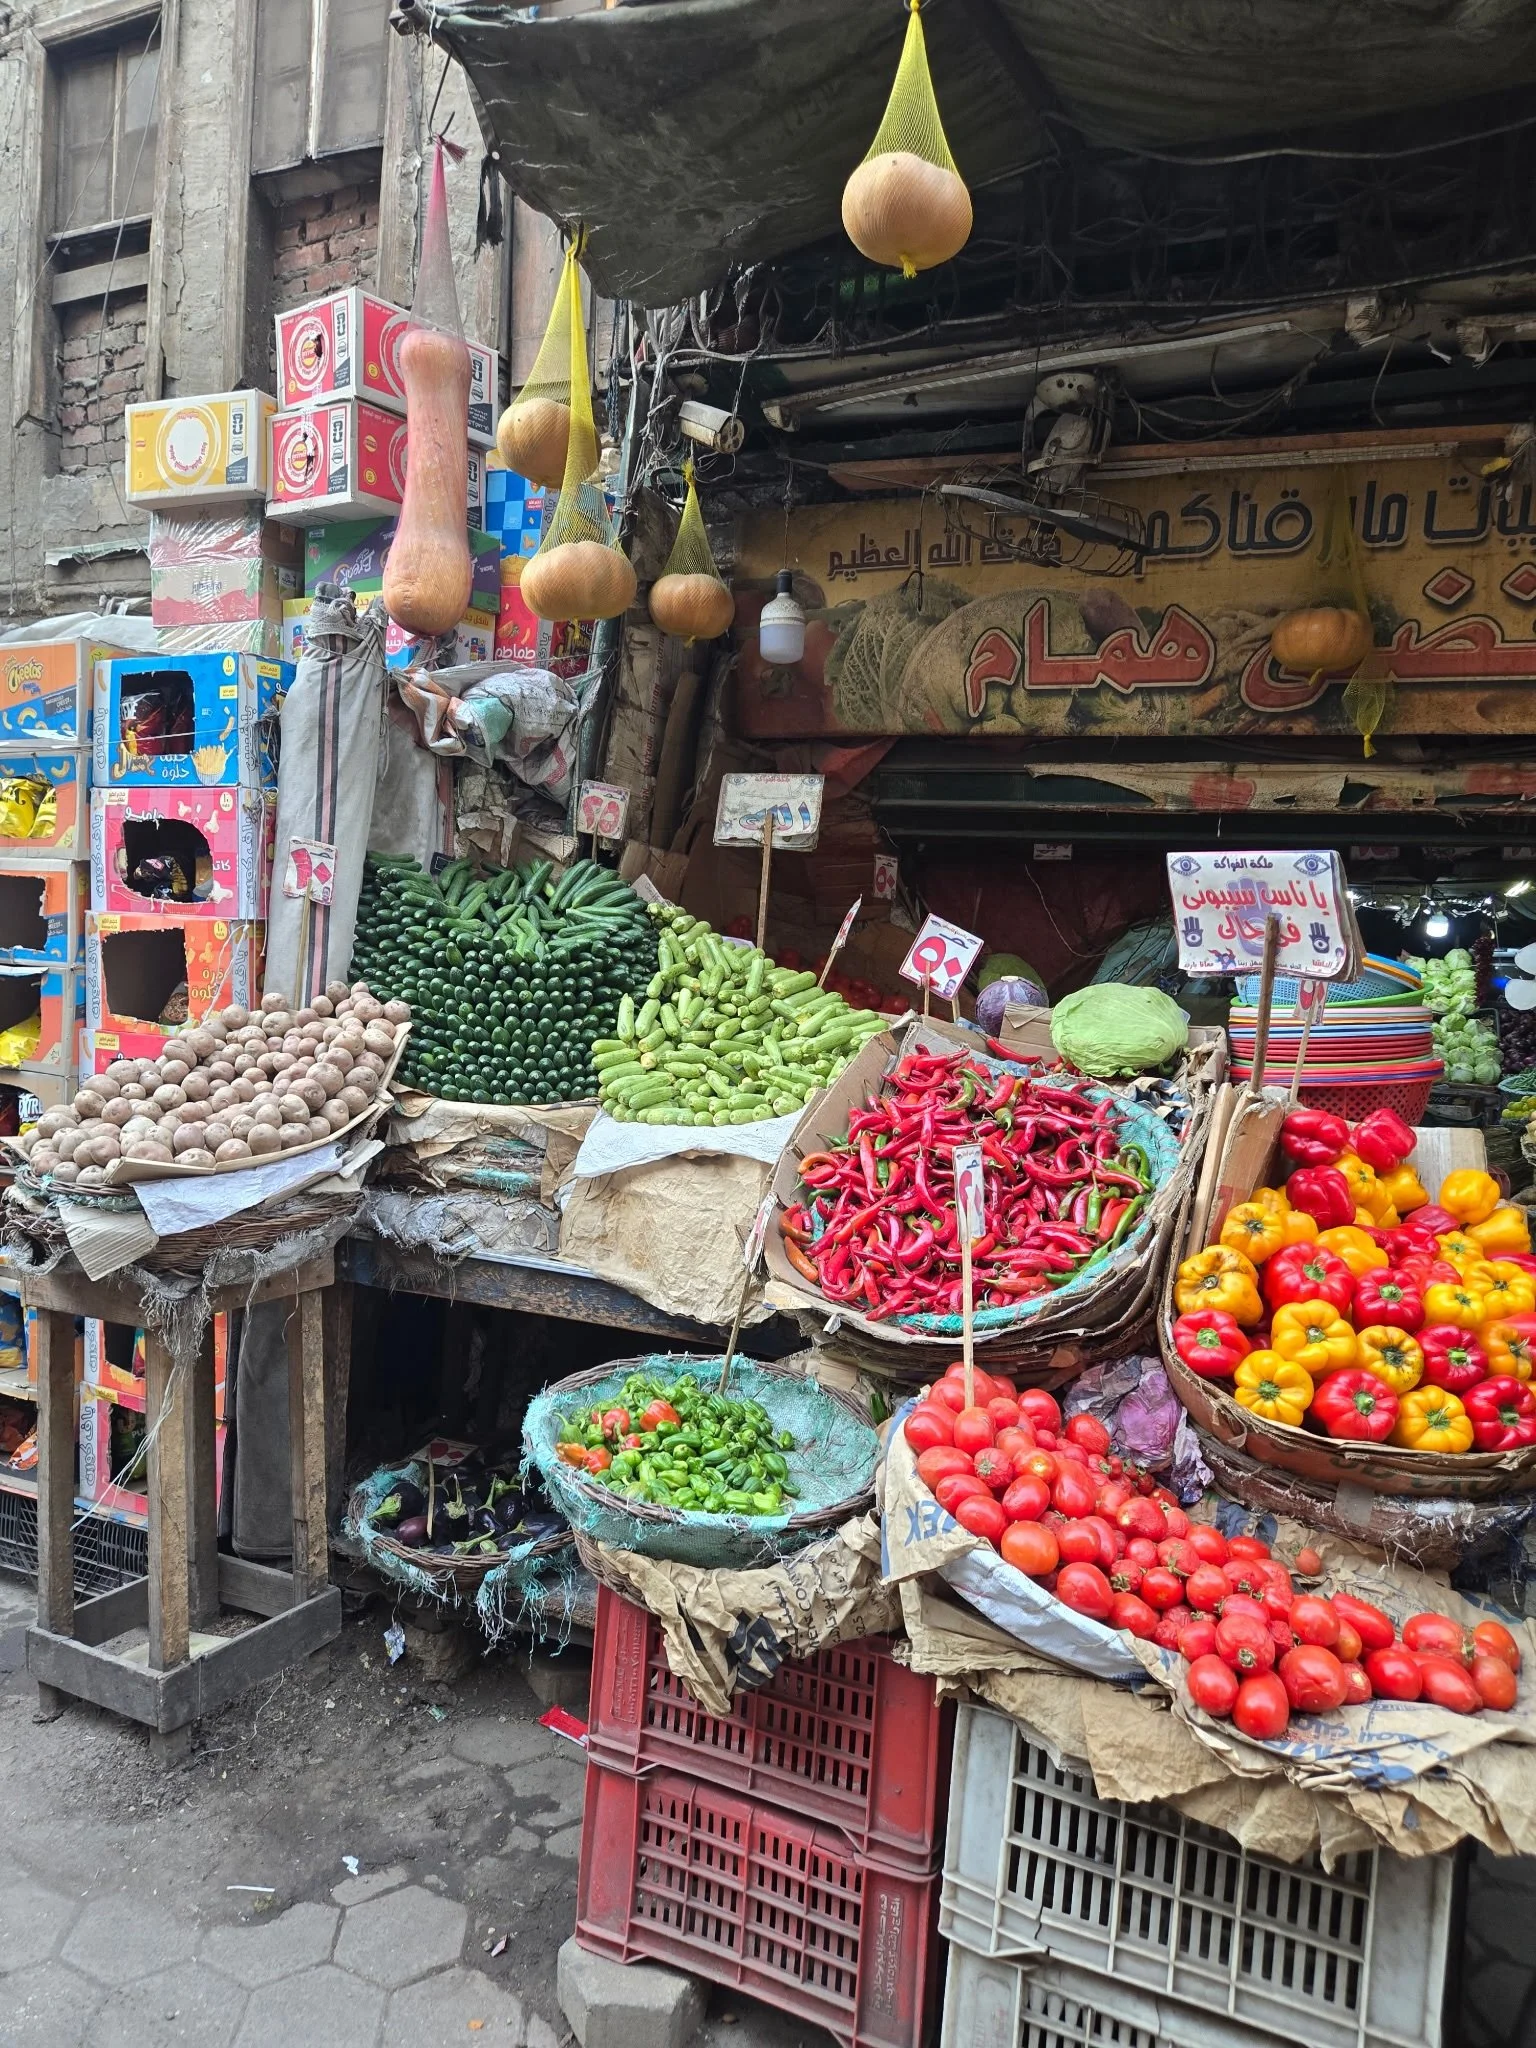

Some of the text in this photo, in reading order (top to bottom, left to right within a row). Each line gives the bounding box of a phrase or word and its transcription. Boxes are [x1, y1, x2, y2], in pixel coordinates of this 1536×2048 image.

[827, 526, 922, 582] العظيم
[8, 656, 43, 693] Cheetos
[963, 597, 1218, 719] همام
[162, 764, 189, 782] حلوة
[1261, 879, 1307, 908] ناس
[1308, 880, 1330, 916] يا
